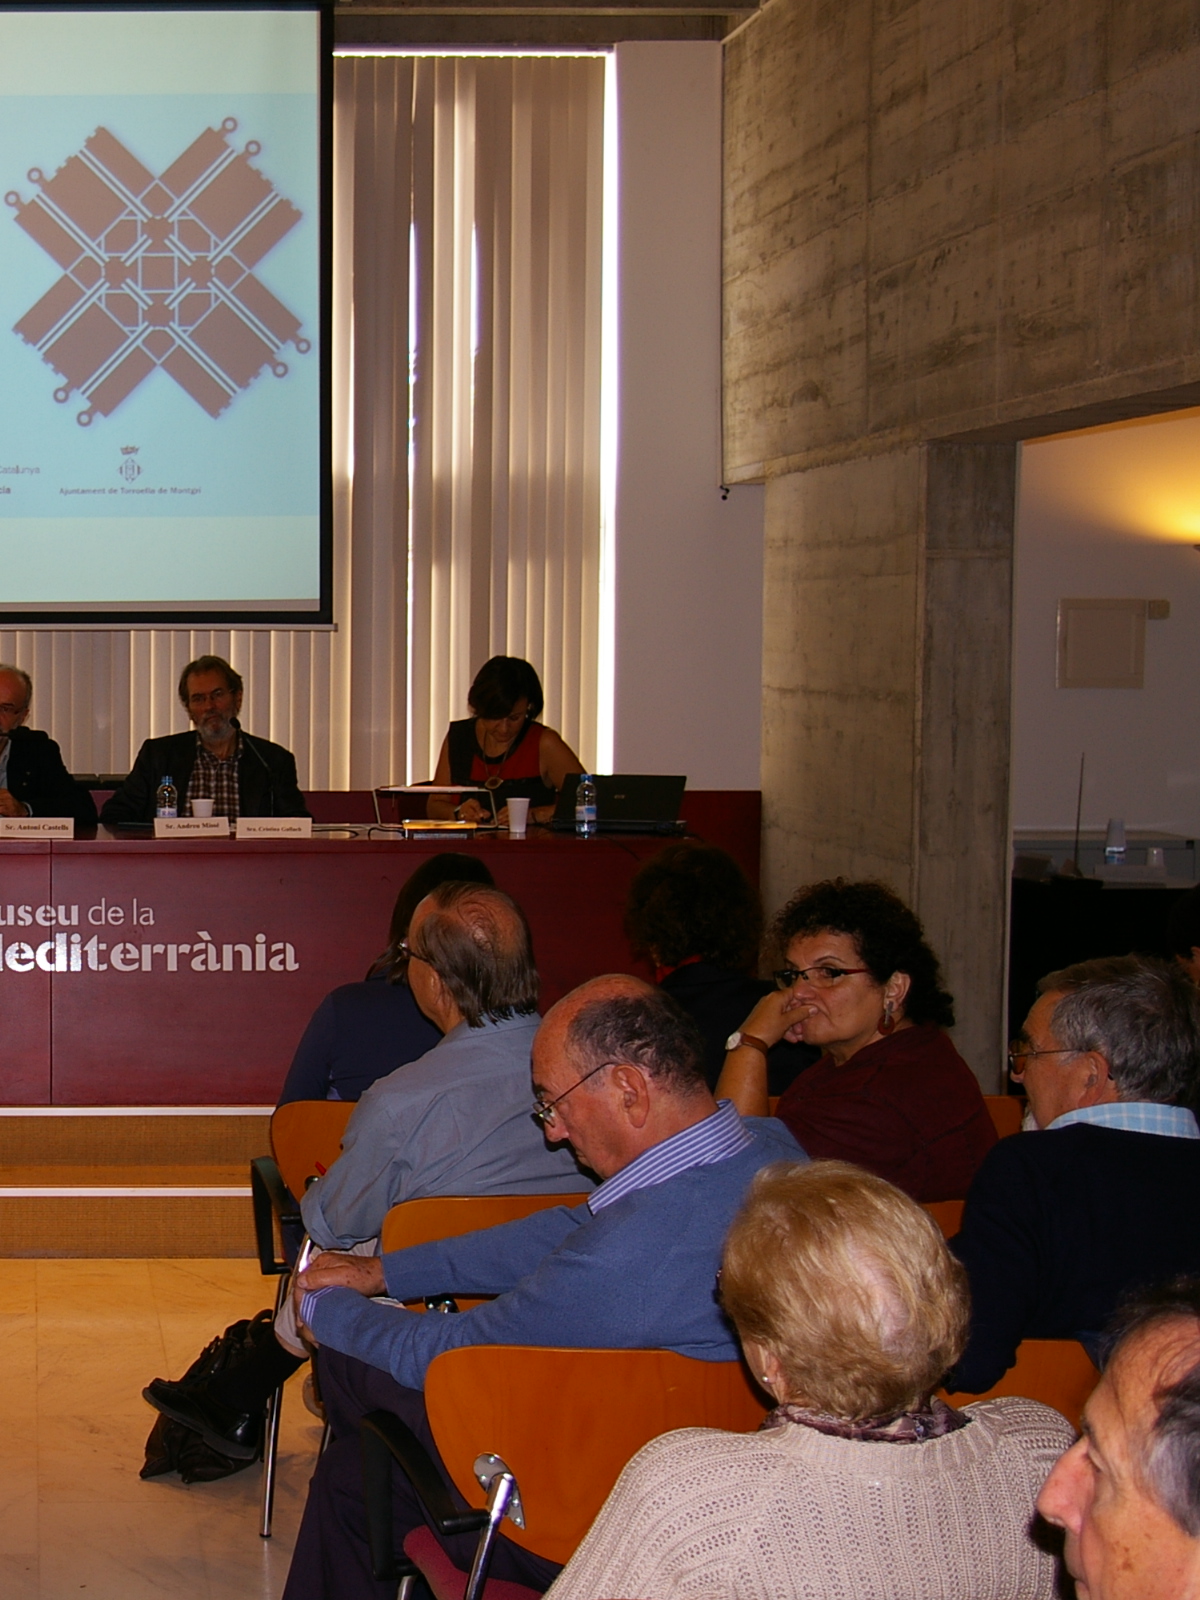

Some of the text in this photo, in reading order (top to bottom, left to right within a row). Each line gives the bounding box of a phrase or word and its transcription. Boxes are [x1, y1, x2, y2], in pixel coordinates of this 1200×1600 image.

[59, 488, 106, 497] Ajuntament
[108, 487, 118, 495] de
[158, 487, 168, 495] de
[87, 898, 125, 926] de
[133, 898, 155, 926] la
